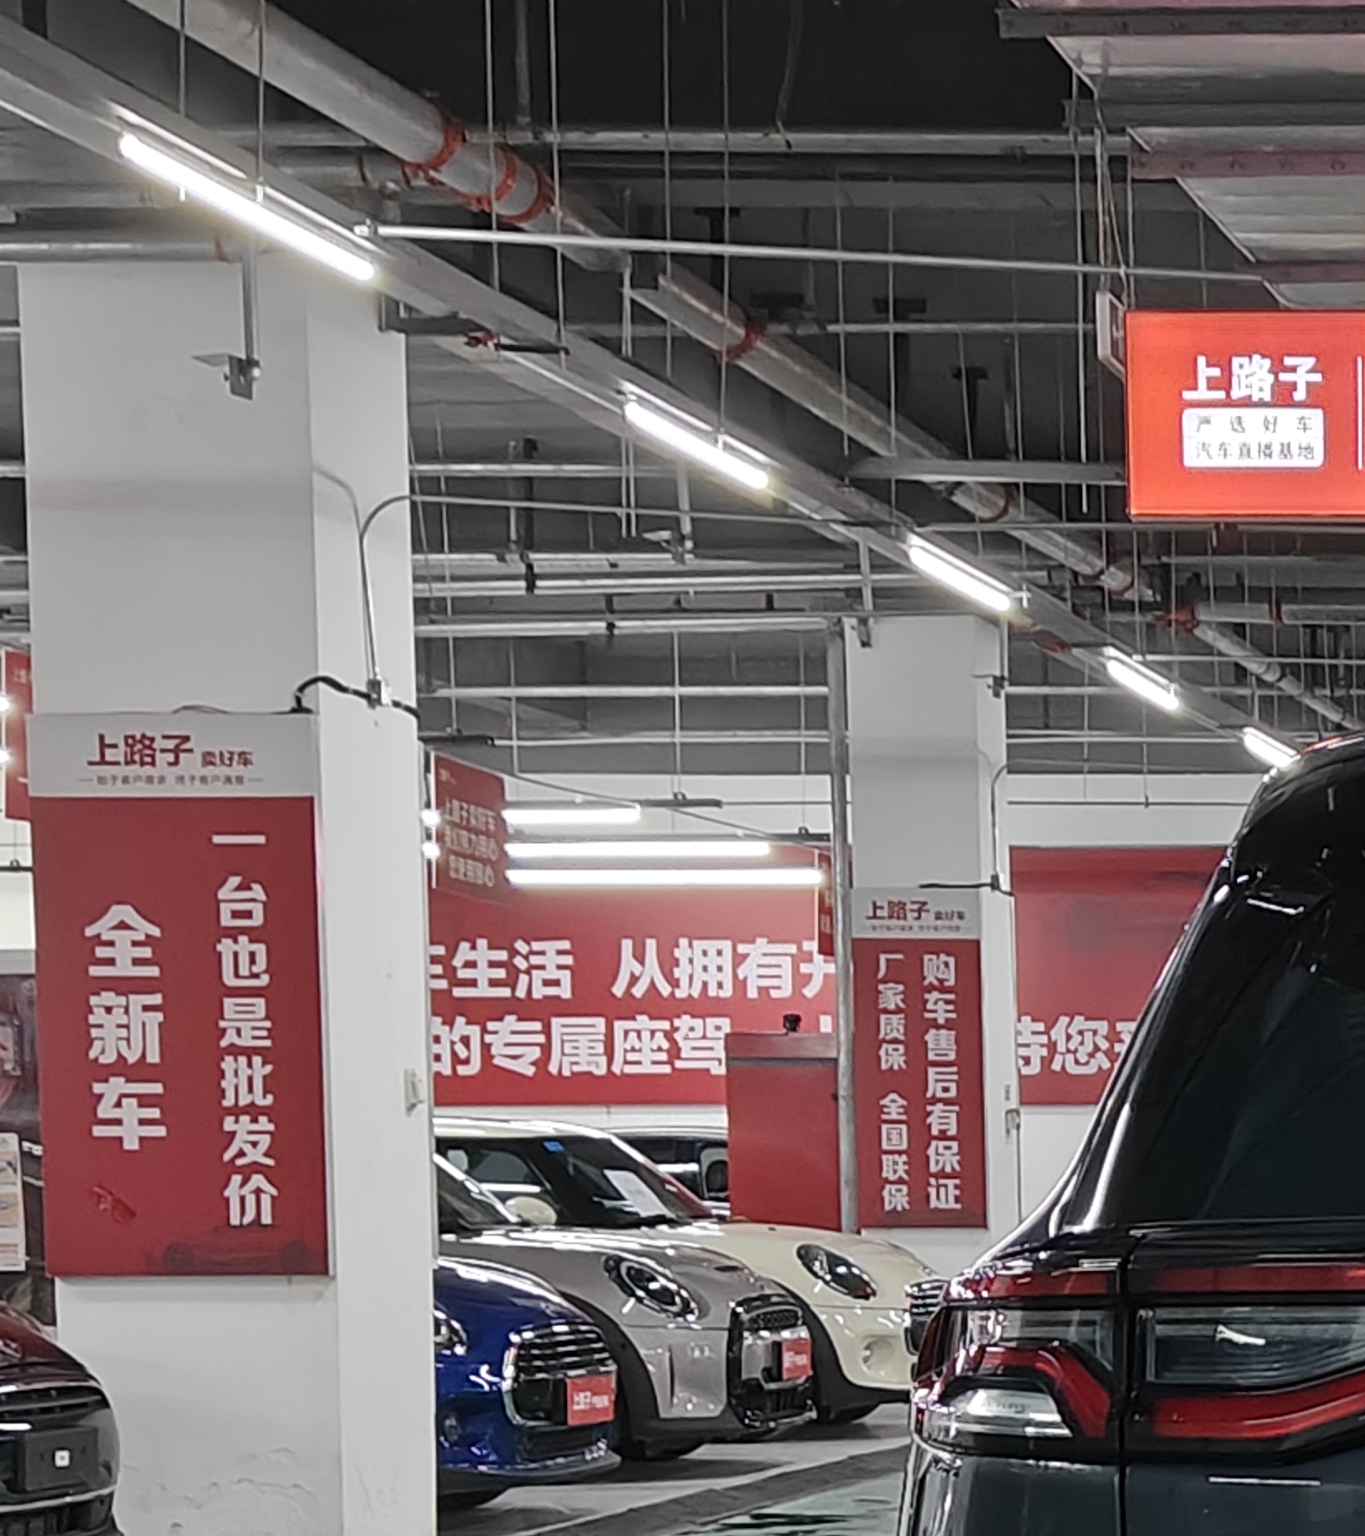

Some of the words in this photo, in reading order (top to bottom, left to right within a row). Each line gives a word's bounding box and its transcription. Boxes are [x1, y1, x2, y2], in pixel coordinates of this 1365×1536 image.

[1181, 354, 1323, 402] 上路子
[87, 733, 194, 767] 上路子
[201, 750, 254, 767] 卖好车
[865, 900, 930, 921] 上路子
[84, 903, 167, 1150] 全新车
[211, 834, 279, 1227] 一台也是批发价
[431, 1014, 731, 1076] 的专属座驾
[876, 953, 907, 1071] 厂家质保
[922, 953, 962, 1210] 购车售后有保证
[879, 1092, 910, 1212] 全国联保
